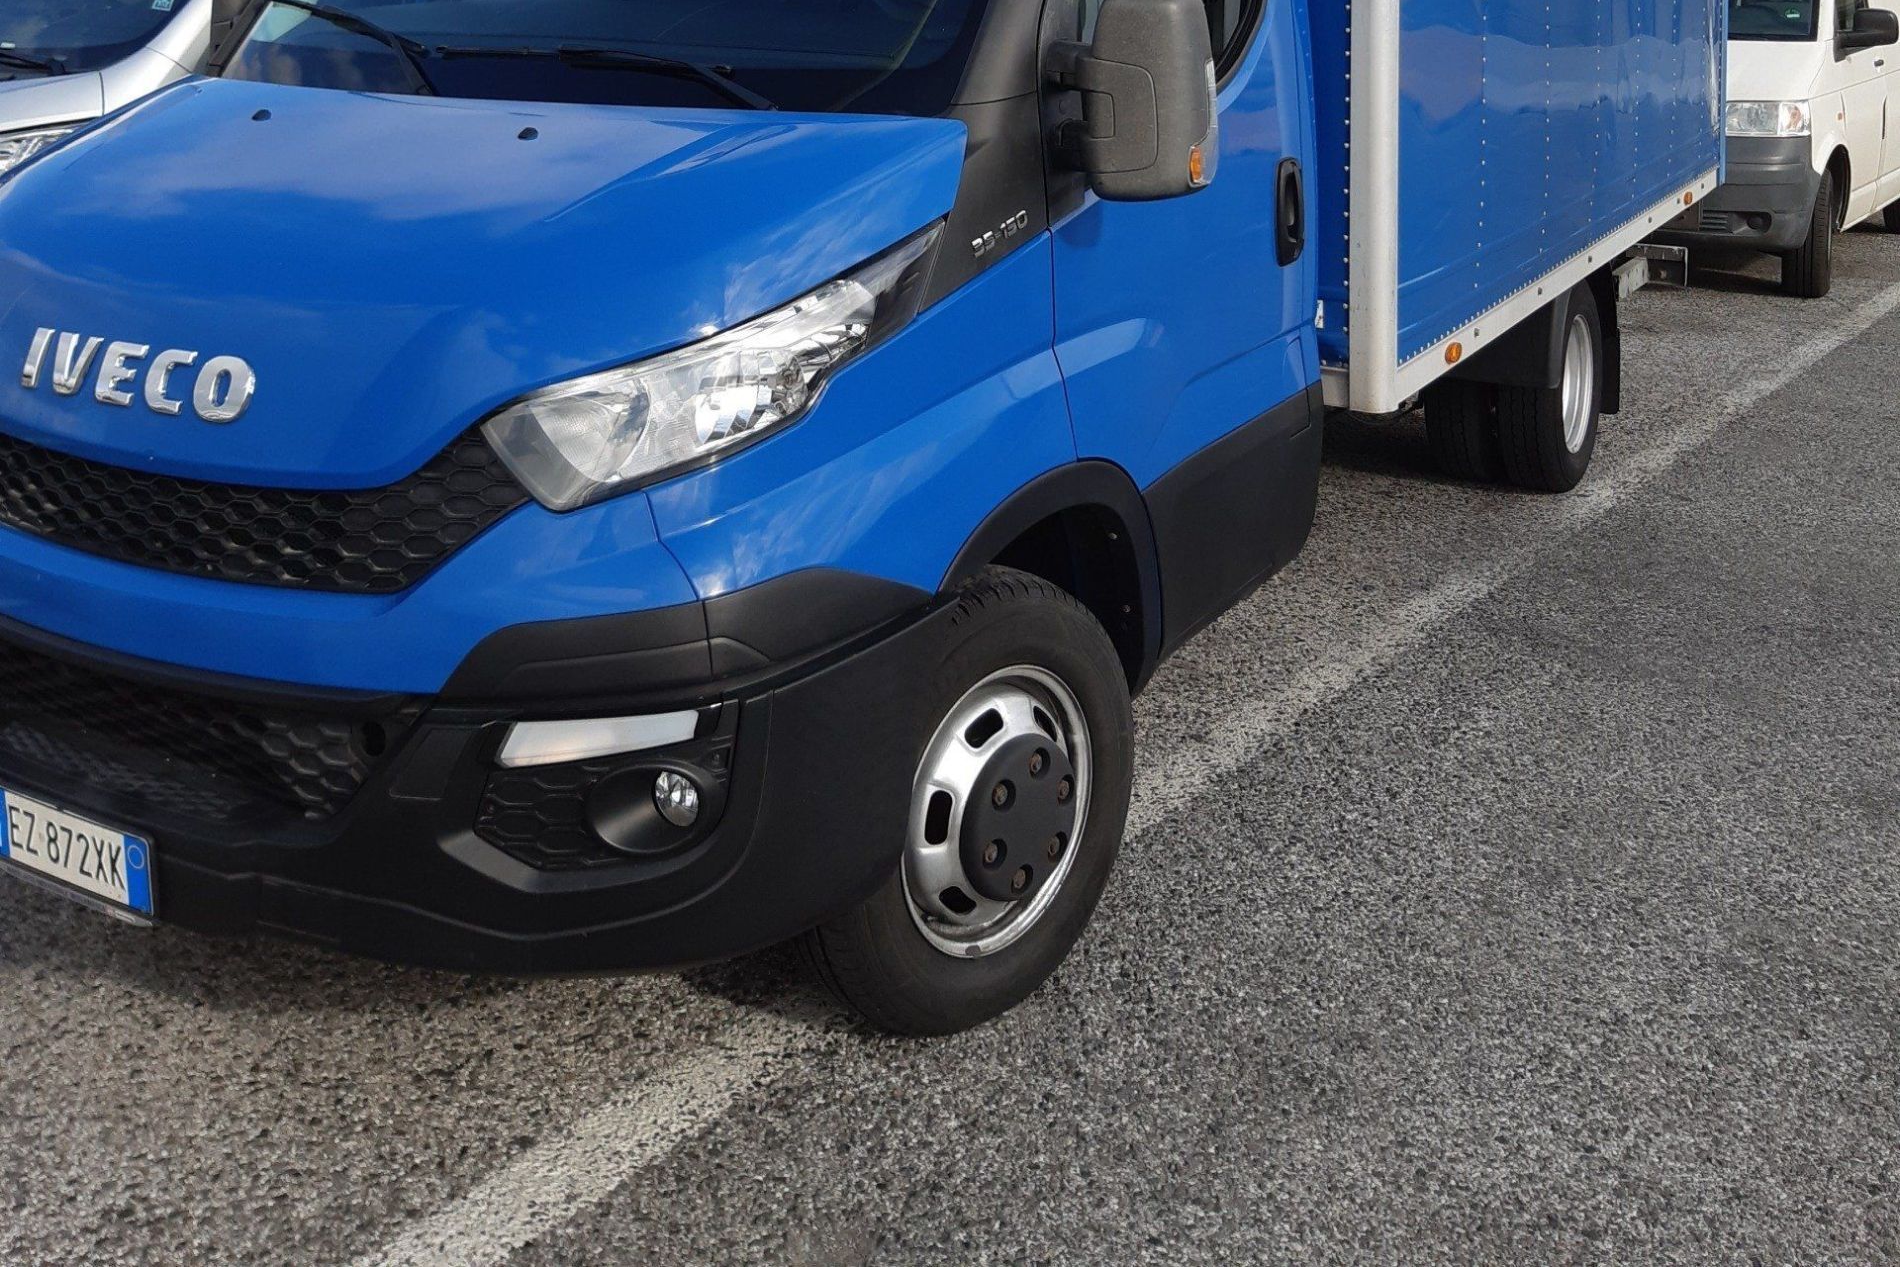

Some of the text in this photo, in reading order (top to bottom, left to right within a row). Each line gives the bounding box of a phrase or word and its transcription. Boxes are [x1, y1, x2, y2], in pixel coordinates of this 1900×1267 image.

[21, 327, 256, 423] IVECO
[9, 805, 126, 891] EZ 872XK
